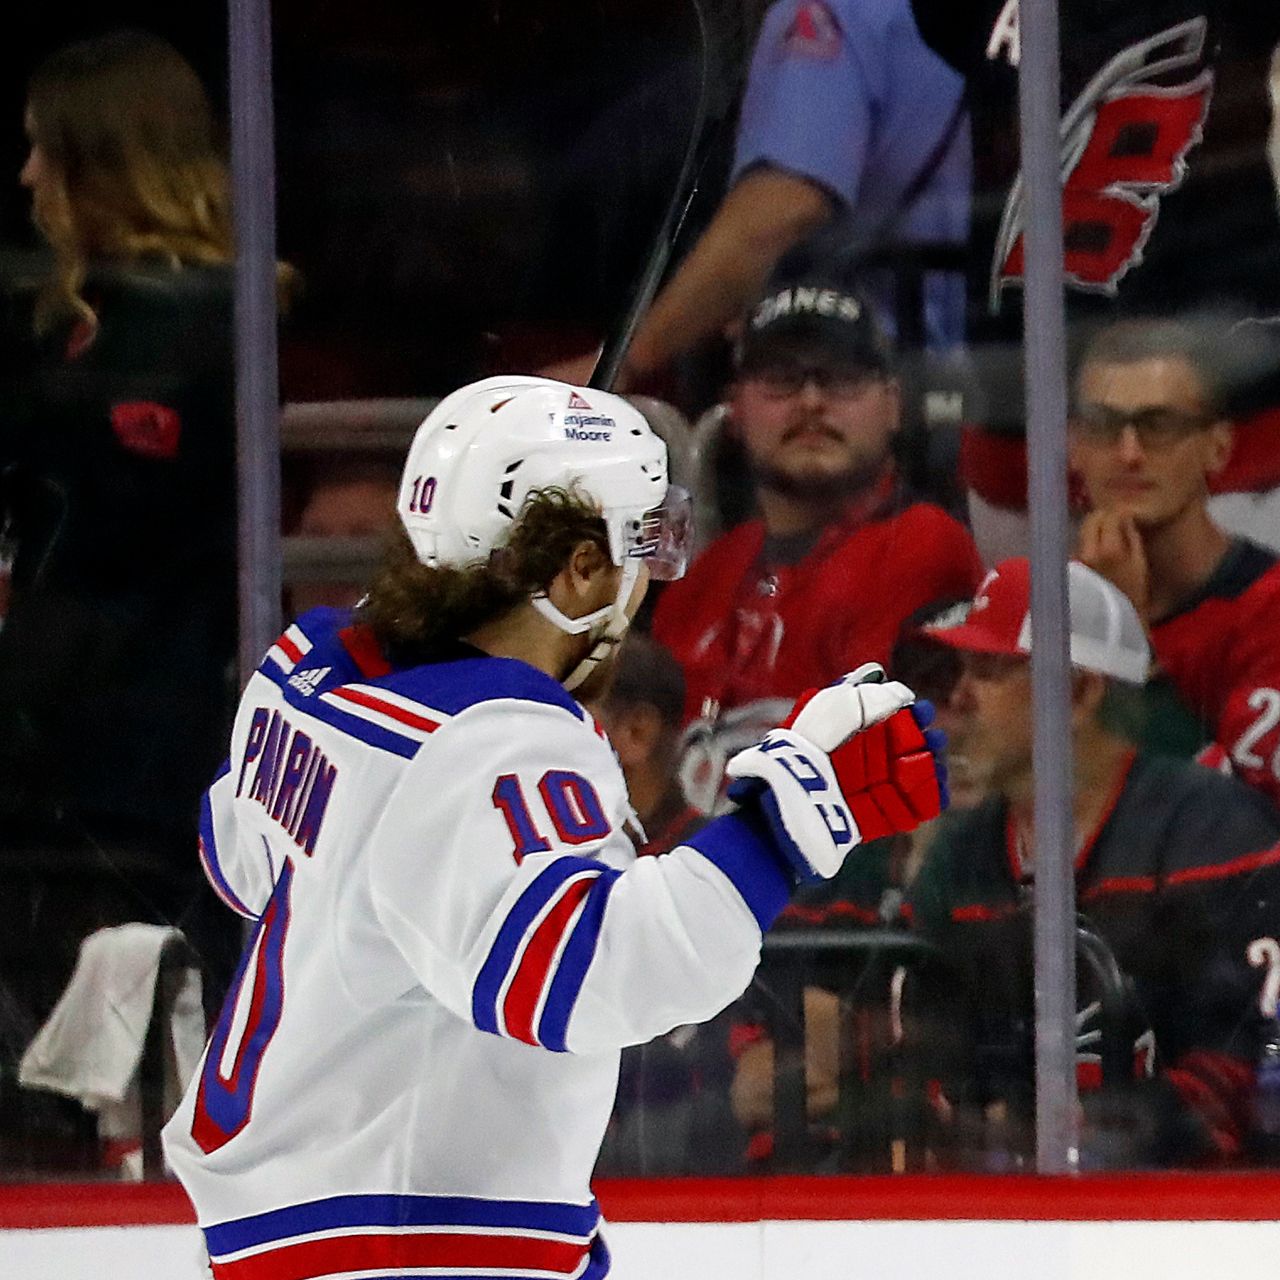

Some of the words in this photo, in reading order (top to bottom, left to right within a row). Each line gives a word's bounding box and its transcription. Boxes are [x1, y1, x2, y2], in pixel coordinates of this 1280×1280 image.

[547, 411, 616, 428] enjamin
[566, 427, 612, 442] Moore
[409, 475, 437, 514] 10
[491, 769, 613, 867] 10
